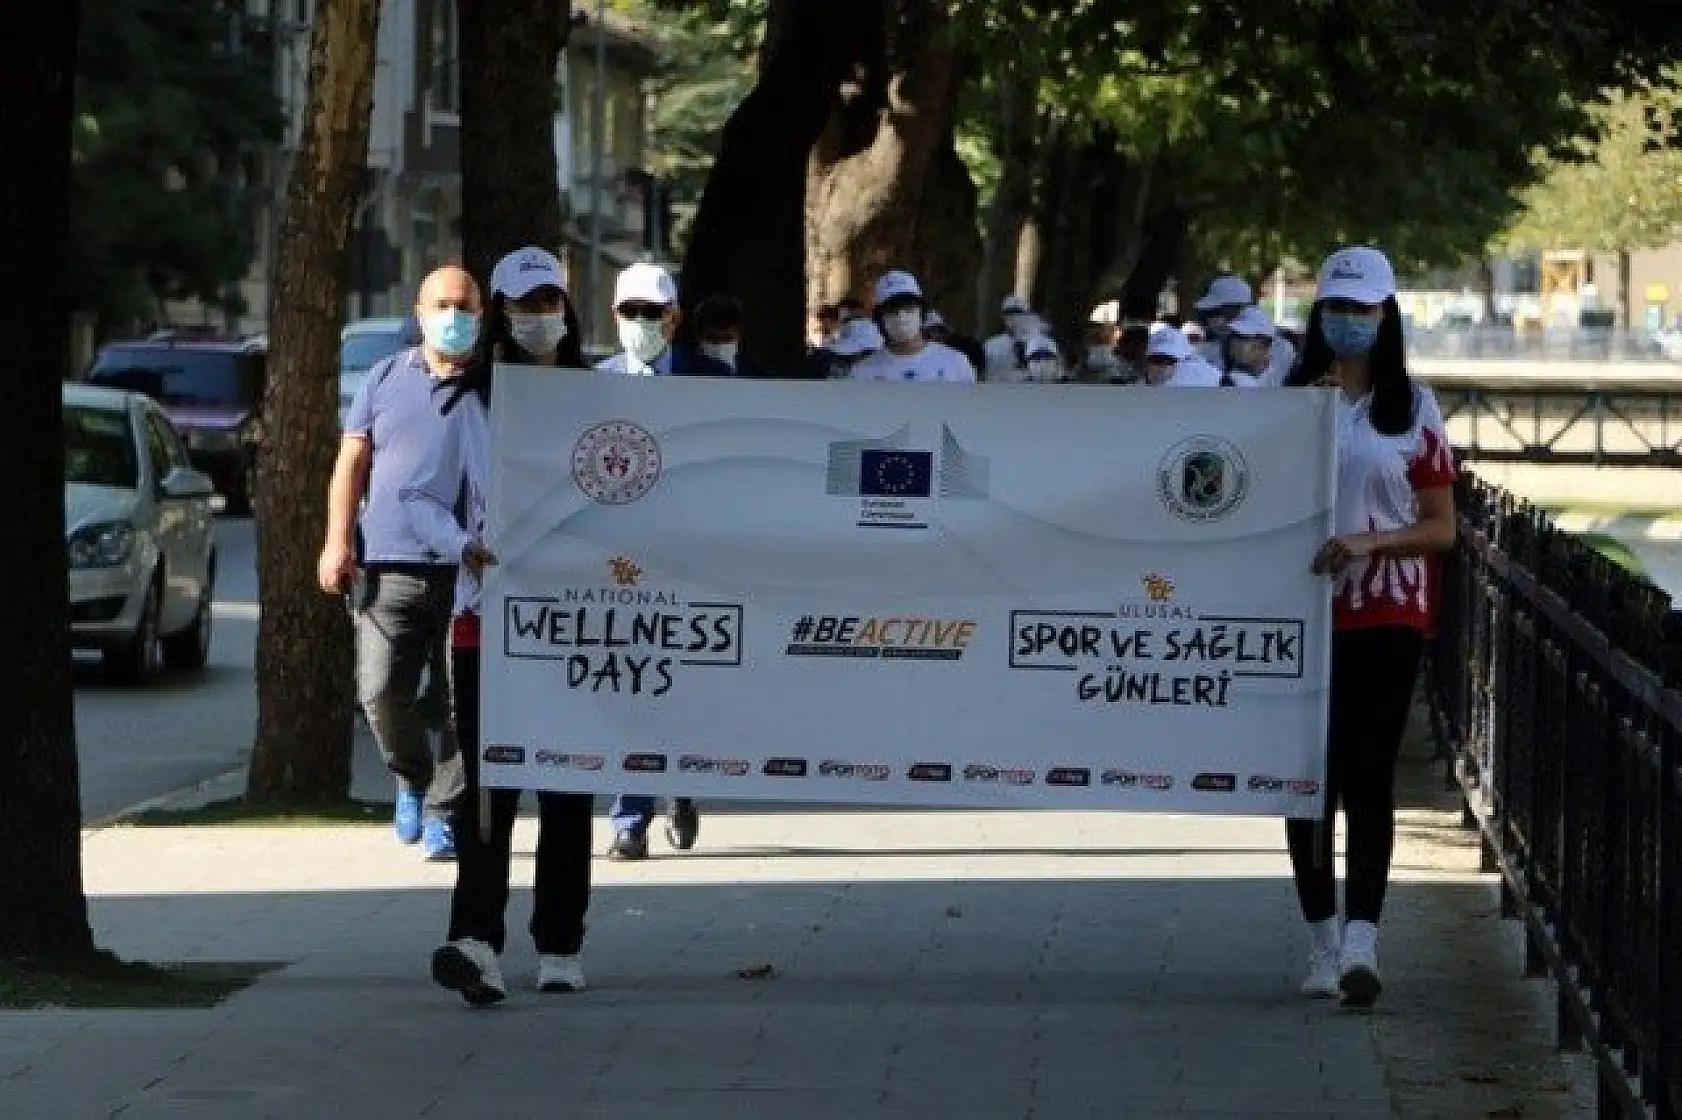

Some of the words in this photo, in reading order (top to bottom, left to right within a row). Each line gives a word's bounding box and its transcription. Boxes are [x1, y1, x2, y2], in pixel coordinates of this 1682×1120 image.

[565, 588, 681, 606] NATIONAL
[1117, 603, 1198, 619] ULUSAL
[511, 604, 731, 652] WELLNESS
[792, 615, 979, 648] #BEACTIVE
[1018, 622, 1101, 658] SPOR
[1110, 629, 1153, 658] VE
[1163, 625, 1298, 663] SAĞLIK
[566, 652, 674, 697] DAYS
[1077, 664, 1233, 707] GÜNLERİ
